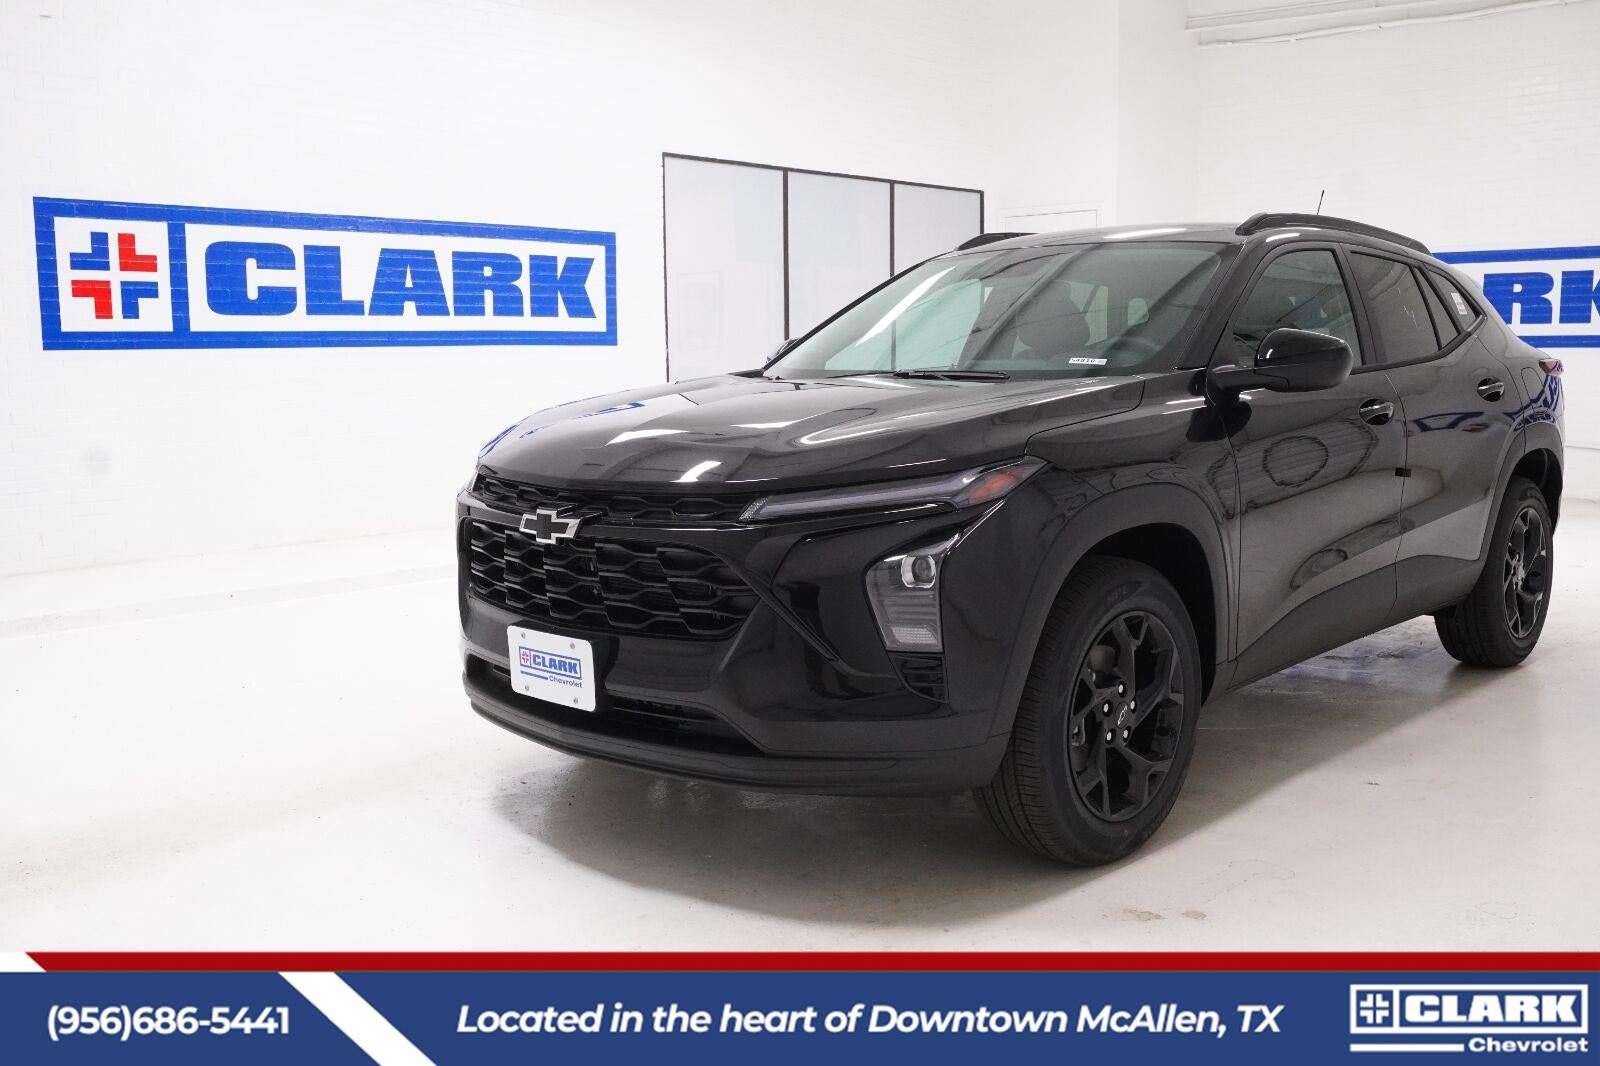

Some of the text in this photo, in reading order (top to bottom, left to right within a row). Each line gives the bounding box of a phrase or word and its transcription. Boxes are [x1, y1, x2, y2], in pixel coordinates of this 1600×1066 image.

[205, 240, 597, 319] CLARK
[532, 654, 579, 674] CLARK
[548, 675, 583, 688] Chevrolet
